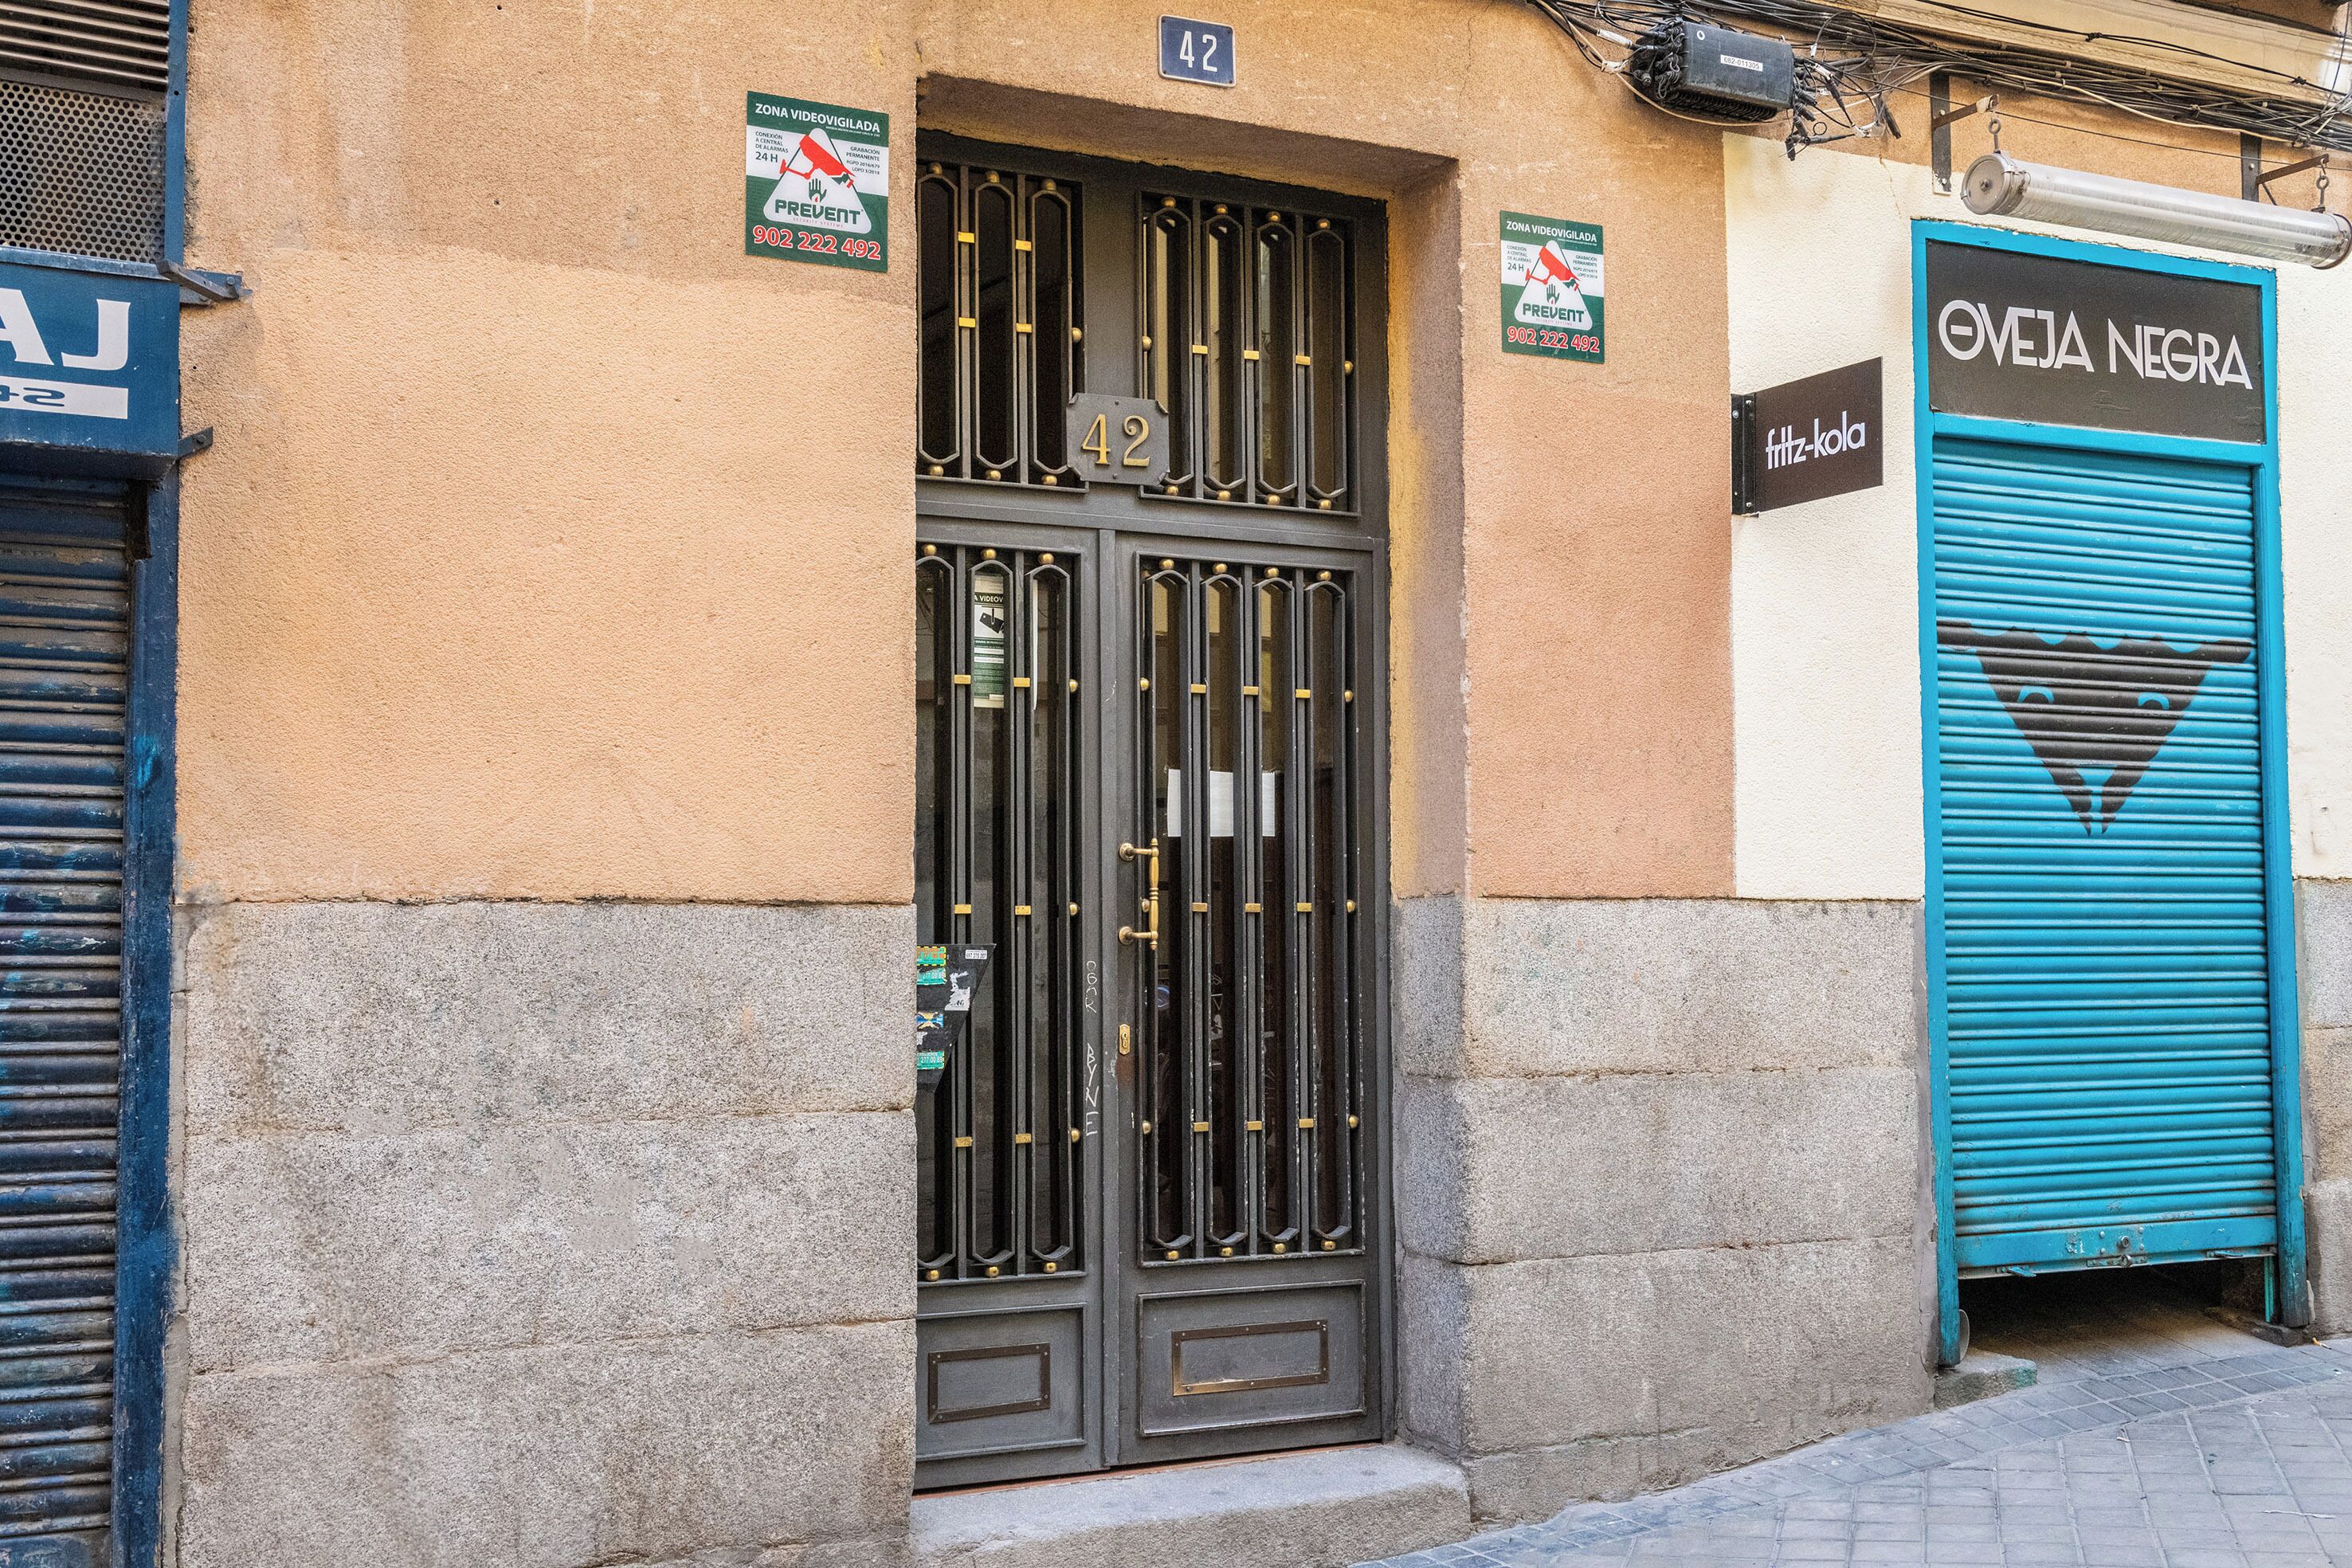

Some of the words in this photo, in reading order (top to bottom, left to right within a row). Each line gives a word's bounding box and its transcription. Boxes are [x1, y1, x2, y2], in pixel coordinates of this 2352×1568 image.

[1179, 30, 1217, 73] 42
[1723, 57, 1759, 70] 082-011305
[755, 103, 789, 119] ZONA
[790, 108, 880, 133] VIDEOVIGILADA
[755, 131, 783, 140] CONEXIÓN
[755, 151, 768, 161] 24
[770, 153, 778, 163] H
[846, 151, 880, 162] PERMANENTE
[850, 146, 880, 155] GRABACIÓN
[774, 199, 861, 225] PREVENT
[753, 225, 794, 249] 902
[798, 231, 837, 254] 222
[841, 238, 881, 261] 492
[1506, 220, 1531, 233] ZONA
[1531, 224, 1597, 243] VIDEOVIGILADA
[1507, 262, 1517, 271] 24
[1523, 303, 1585, 323] PREVENT
[1507, 325, 1537, 345] 902
[1540, 330, 1569, 349] 222
[1571, 335, 1601, 353] 492
[1938, 299, 2095, 373] OVEJA
[2107, 317, 2254, 390] NEGRA
[1081, 414, 1151, 467] 42
[1765, 410, 1866, 470] fritz-kola
